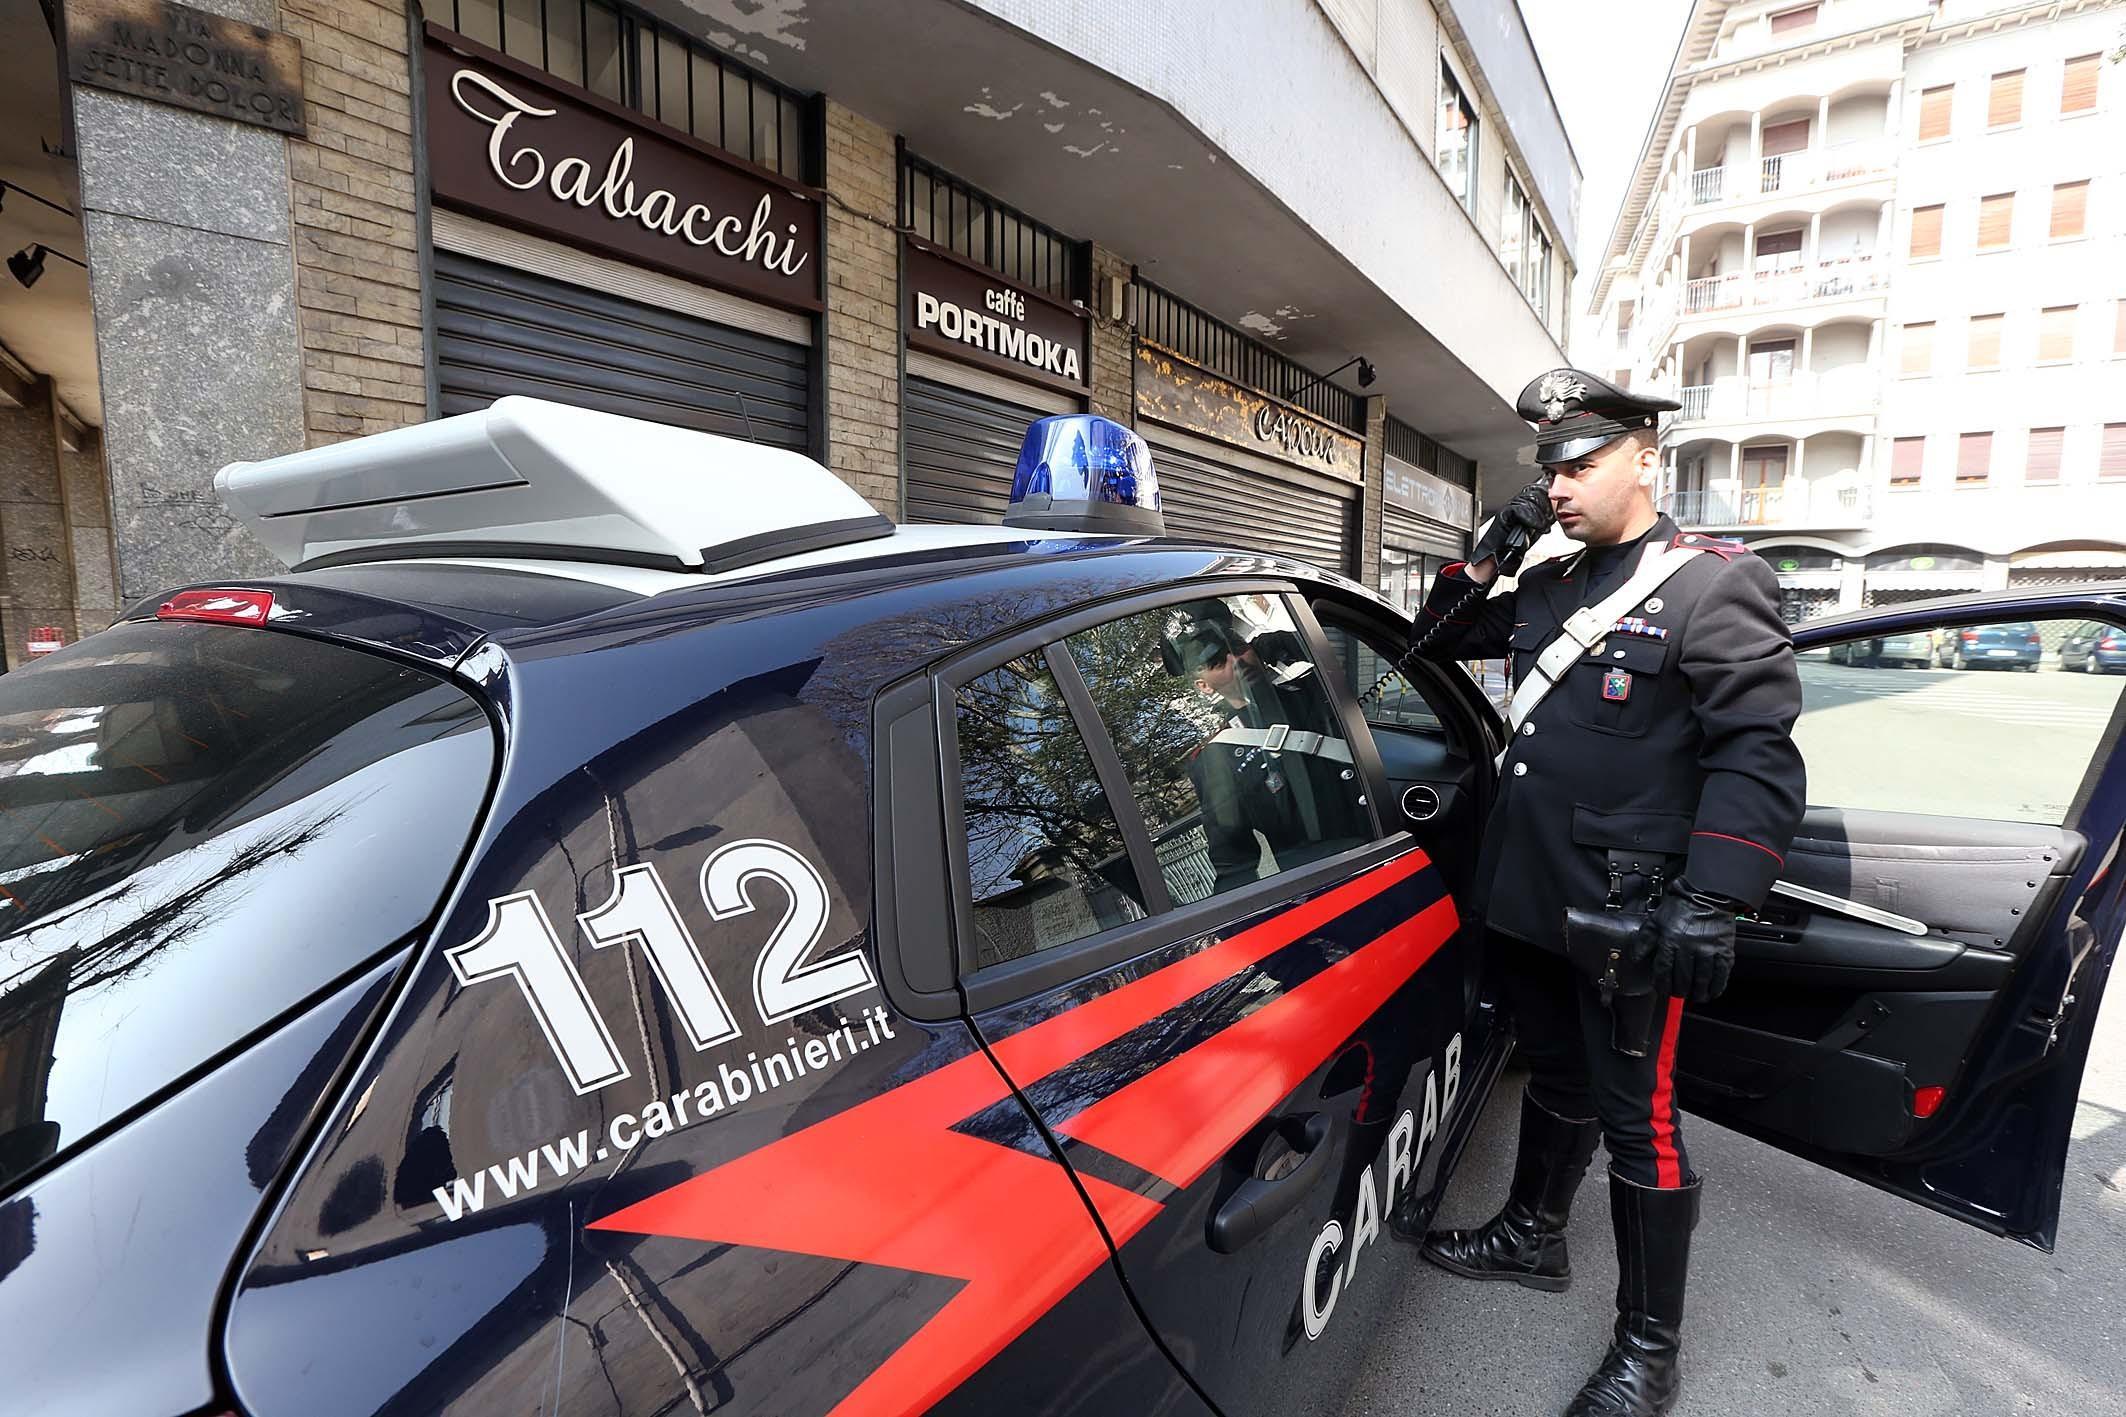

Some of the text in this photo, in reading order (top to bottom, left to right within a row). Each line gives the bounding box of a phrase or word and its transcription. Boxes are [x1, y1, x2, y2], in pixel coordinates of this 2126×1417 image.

[83, 50, 170, 91] SETTE
[112, 21, 266, 83] MADONNA
[451, 69, 808, 275] Tabacchi
[917, 292, 1082, 380] PORTMOKA
[986, 287, 1026, 322] caffè
[443, 838, 878, 1096] 112
[432, 1005, 896, 1222] www.carabinieri.it
[1303, 1033, 1461, 1341] CARAB
